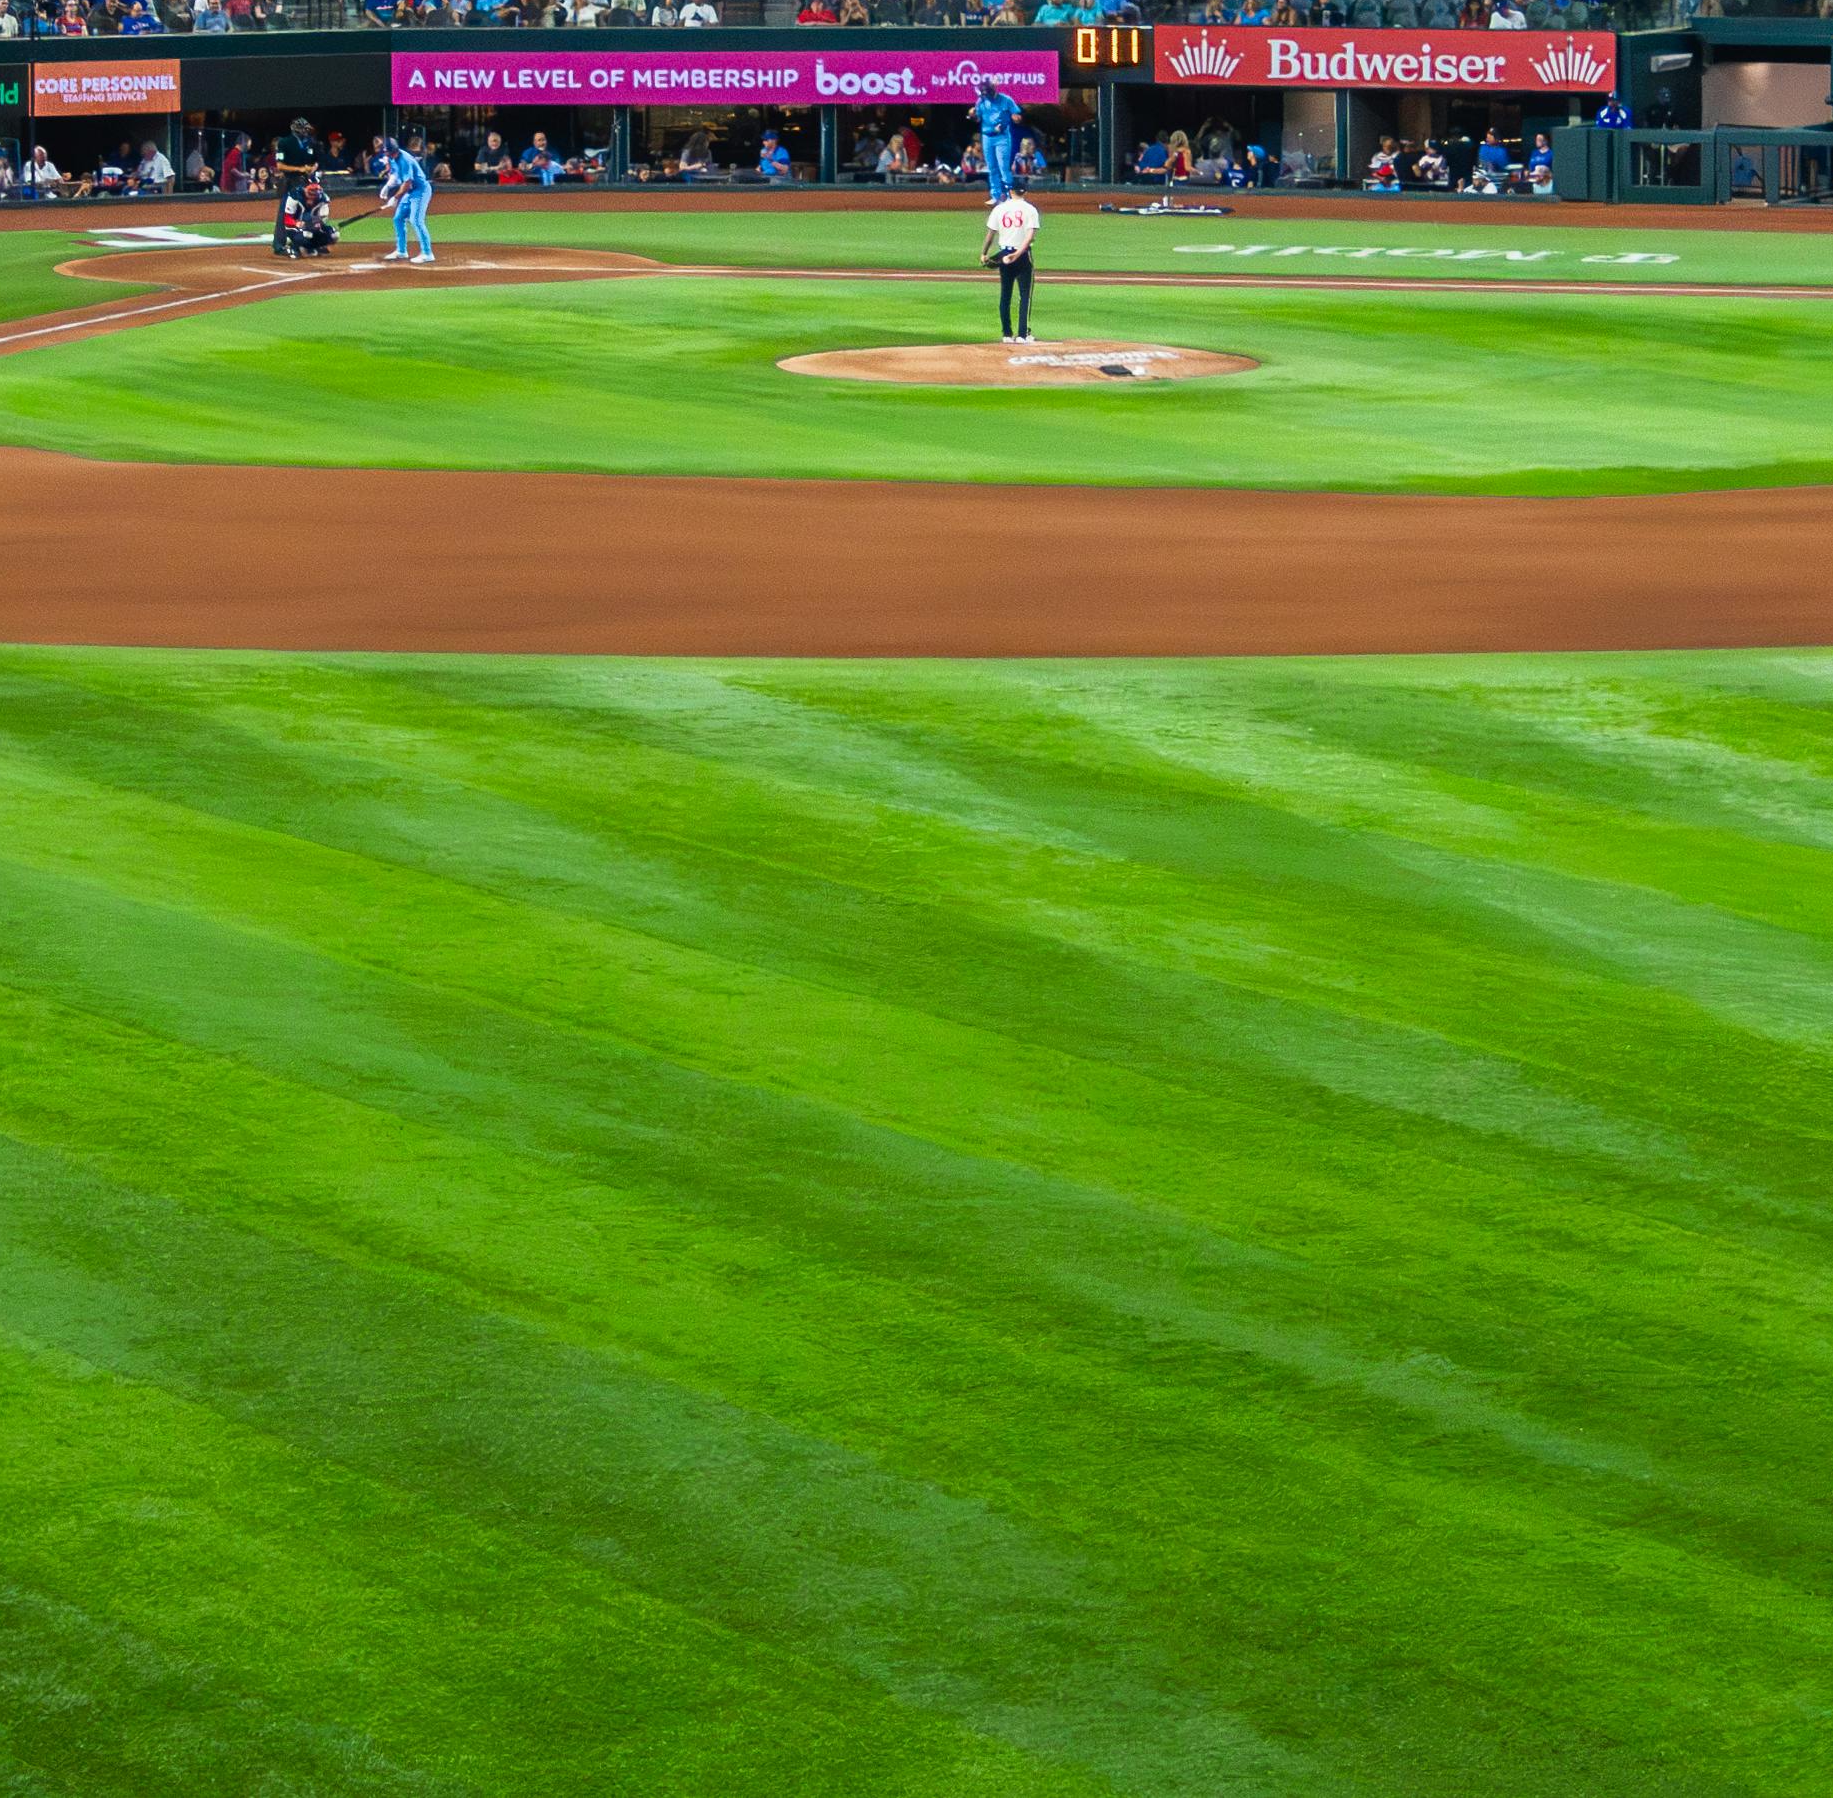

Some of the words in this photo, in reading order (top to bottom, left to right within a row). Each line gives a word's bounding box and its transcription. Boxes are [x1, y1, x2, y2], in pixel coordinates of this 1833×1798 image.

[1267, 39, 1502, 83] Budweiser
[35, 77, 78, 94] CORE
[81, 74, 177, 91] PERSONNEL
[408, 69, 426, 88] A
[434, 69, 495, 89] NEW
[503, 69, 582, 89] LEVEL
[590, 69, 624, 89] OF
[633, 68, 799, 89] MEMBERSHIP
[816, 58, 915, 95] boost
[931, 75, 947, 86] by
